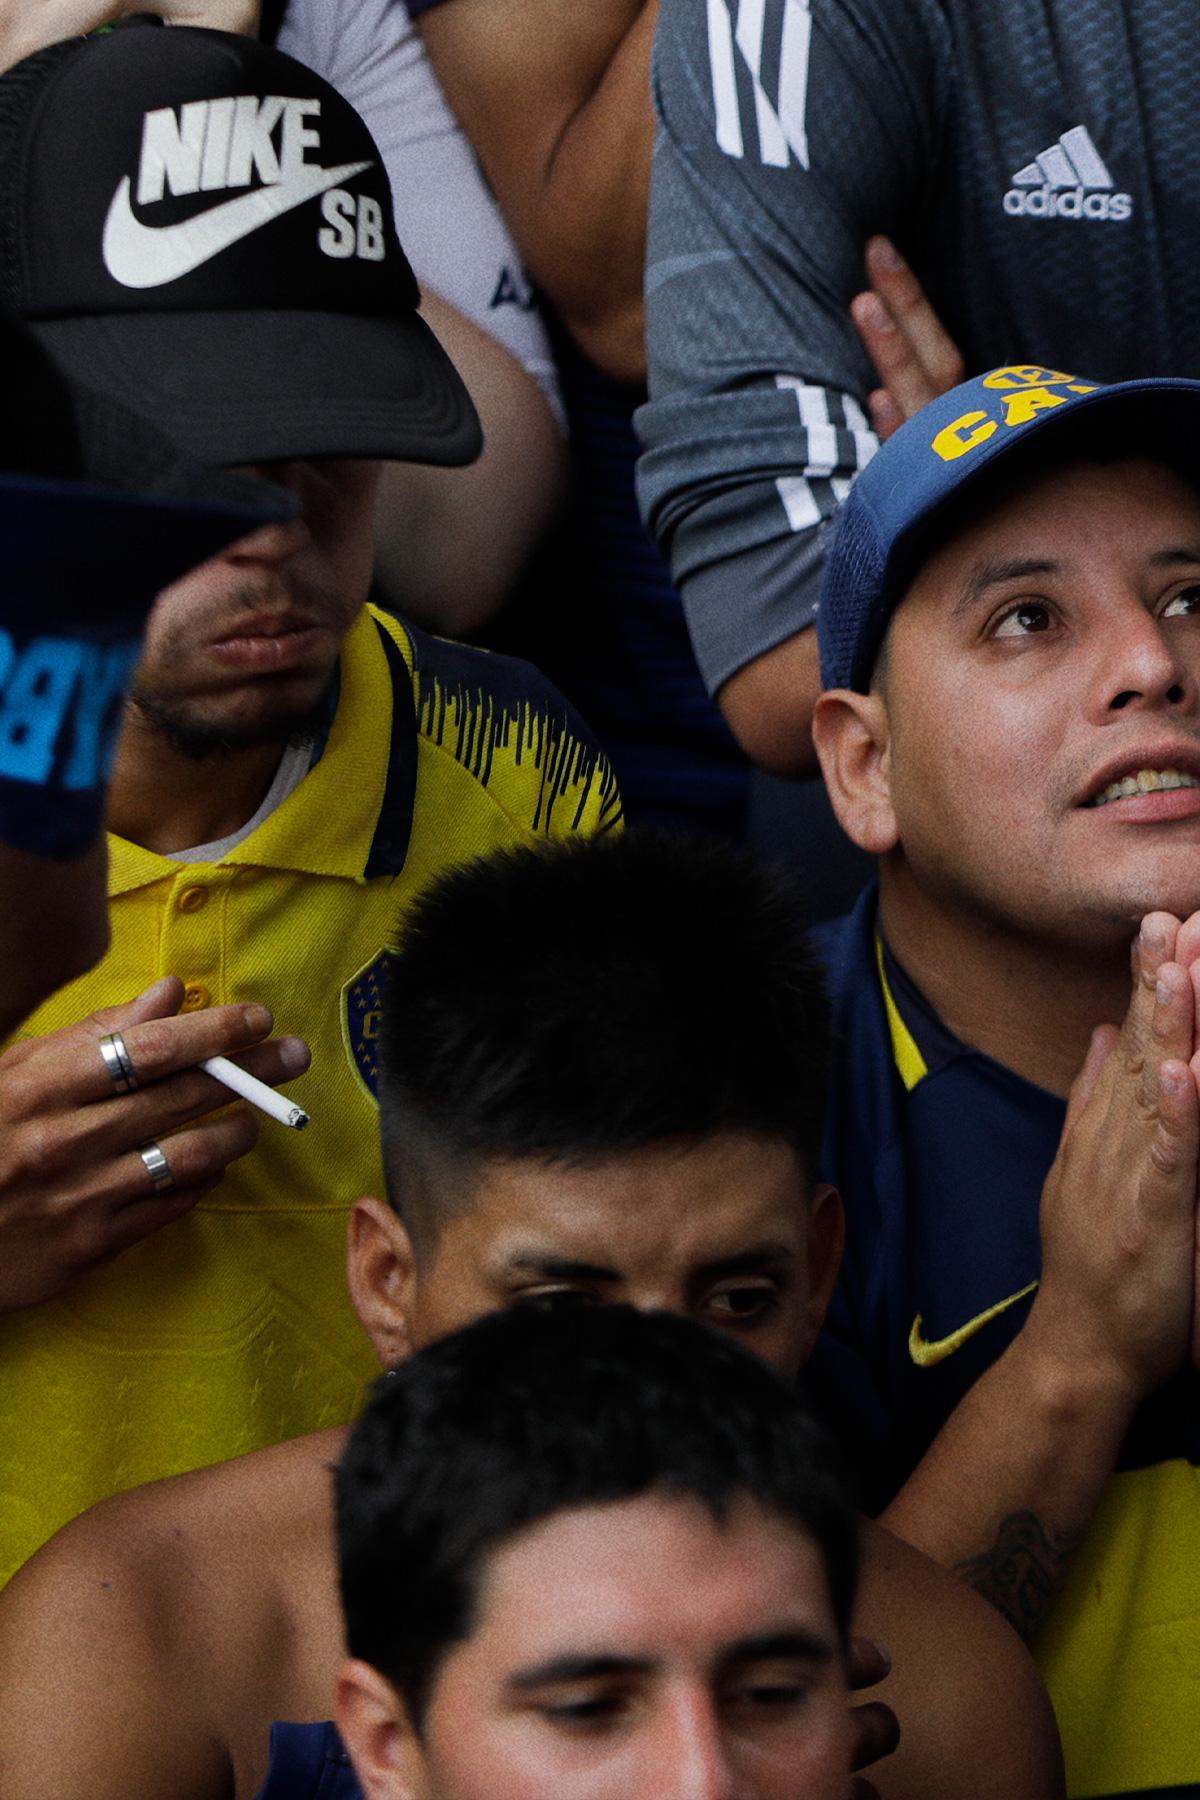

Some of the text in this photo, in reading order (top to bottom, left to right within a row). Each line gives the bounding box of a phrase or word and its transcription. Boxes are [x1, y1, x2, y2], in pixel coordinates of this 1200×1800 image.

[137, 95, 320, 205] NIKE
[318, 188, 386, 261] SB
[1002, 183, 1132, 221] adidas
[931, 385, 1101, 461] CA
